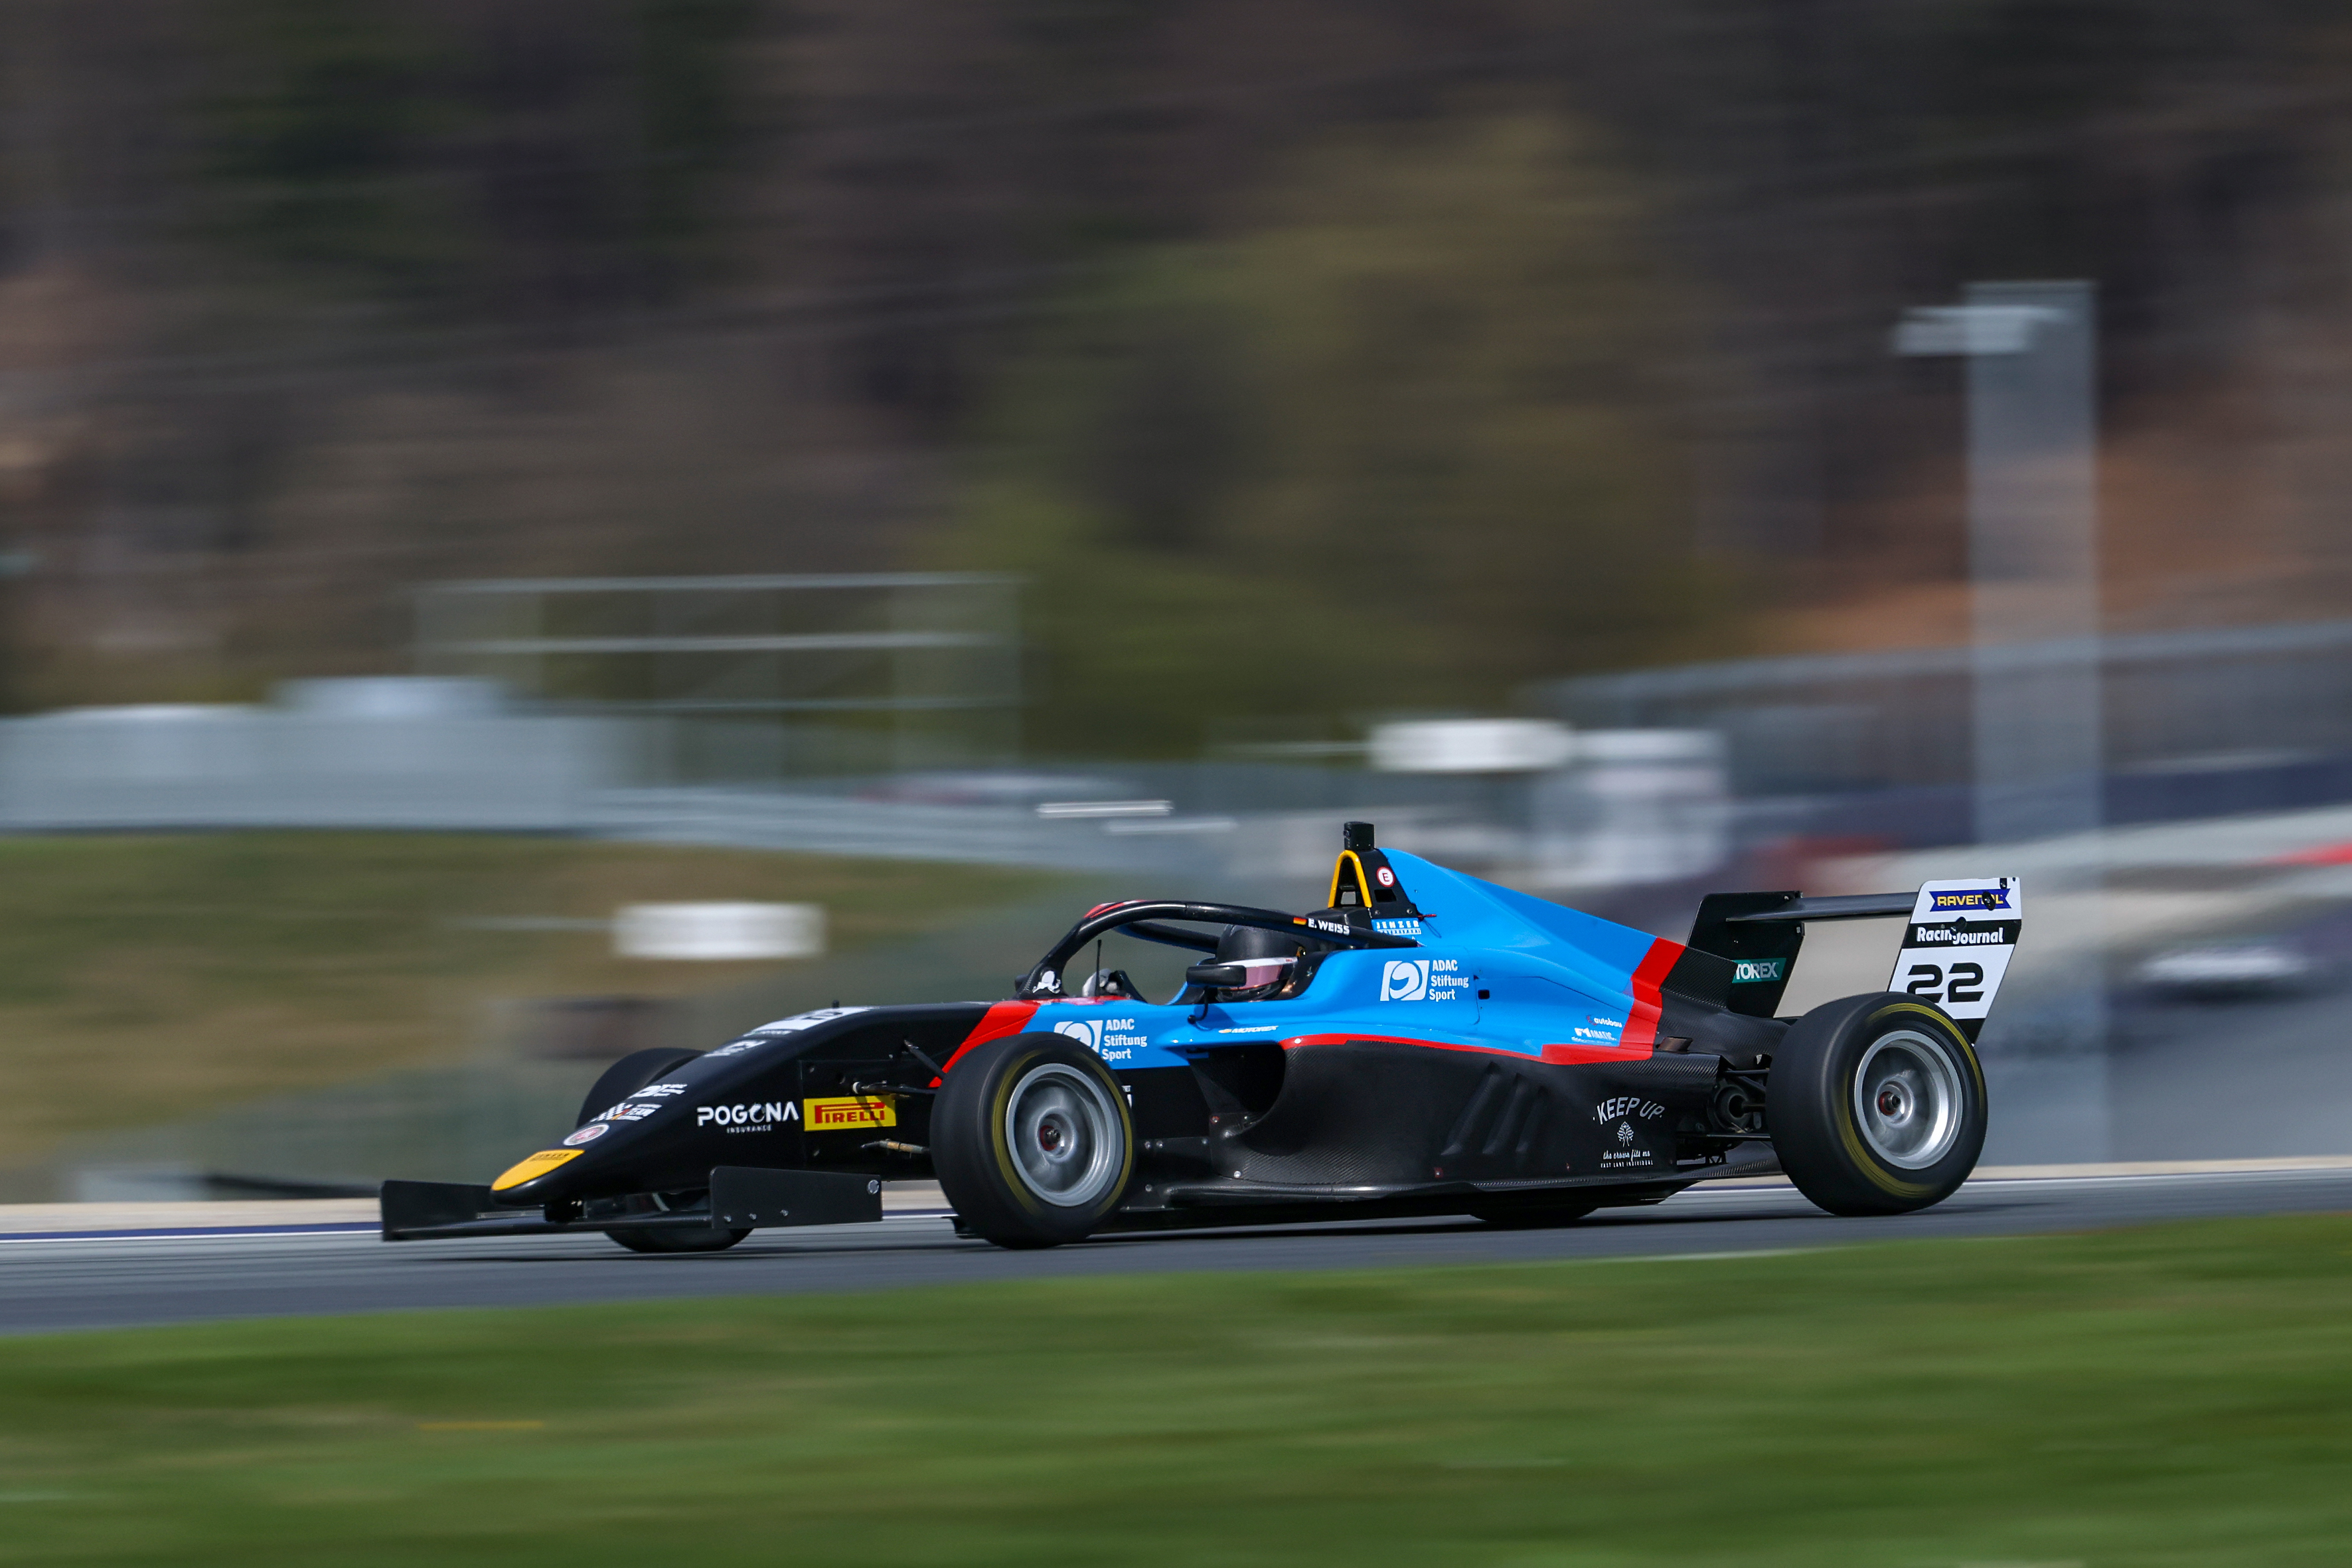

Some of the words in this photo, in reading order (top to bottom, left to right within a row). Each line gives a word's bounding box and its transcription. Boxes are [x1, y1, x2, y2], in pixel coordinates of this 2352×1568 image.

[1382, 872, 1389, 882] E
[1937, 894, 2004, 907] RAVENL
[1308, 918, 1317, 929] E.
[1318, 919, 1350, 936] WEISS
[1376, 920, 1419, 929] JENZER
[1432, 959, 1458, 972] ADAC
[1431, 975, 1469, 988] Stiftung
[1907, 962, 1985, 1004] 22
[1429, 988, 1456, 1002] Sport
[1105, 1018, 1135, 1031] ADAC
[1103, 1034, 1148, 1048] Stiftung
[1101, 1048, 1132, 1061] Sport
[697, 1101, 799, 1127] POGONA
[815, 1101, 886, 1124] PIRELLI
[1597, 1097, 1640, 1125] KEEP
[726, 1124, 772, 1134] INSURANCE
